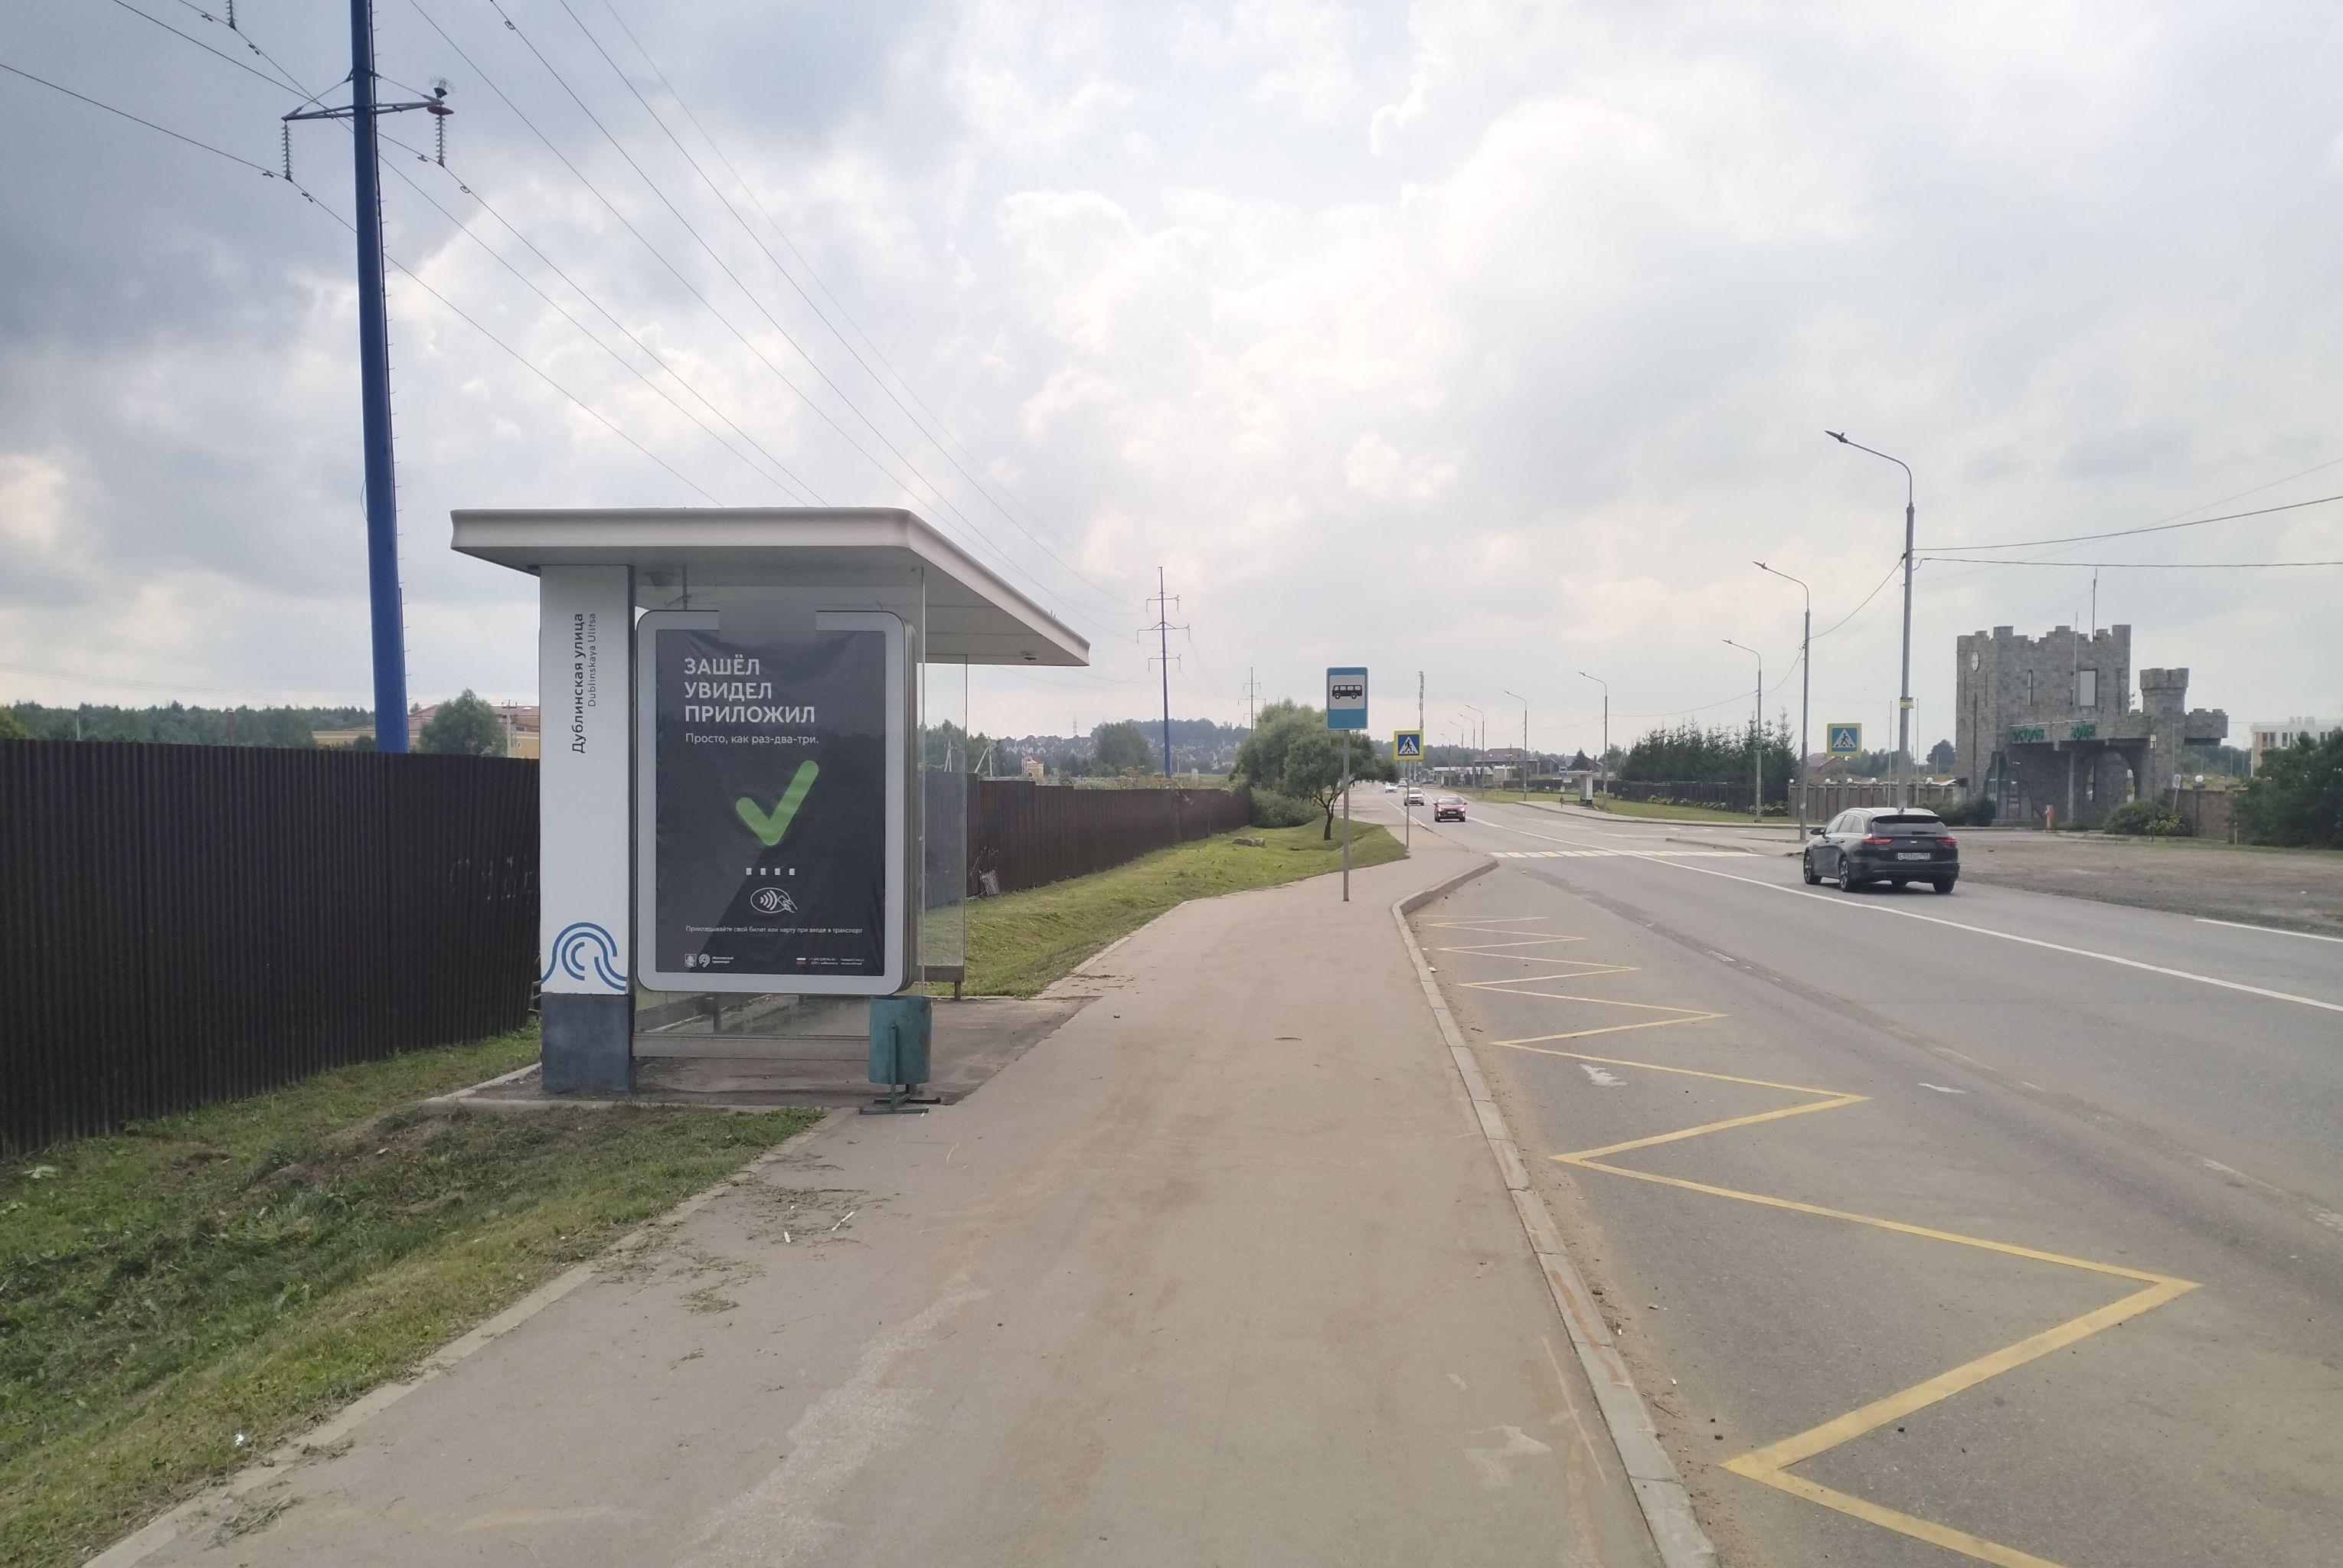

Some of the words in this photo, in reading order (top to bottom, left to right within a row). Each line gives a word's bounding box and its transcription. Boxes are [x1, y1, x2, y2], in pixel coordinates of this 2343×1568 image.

[574, 613, 586, 658] улица
[587, 613, 596, 642] Ulitsa
[587, 645, 597, 707] Dublinskaya
[684, 654, 760, 675] ЗАШЁЛ
[684, 681, 772, 702] УВИДЕЛ
[571, 663, 586, 754] Дублинская
[685, 705, 815, 724] ПРИЛОЖИЛ
[685, 733, 728, 745] Просто,
[752, 735, 819, 746] раз-два-три.
